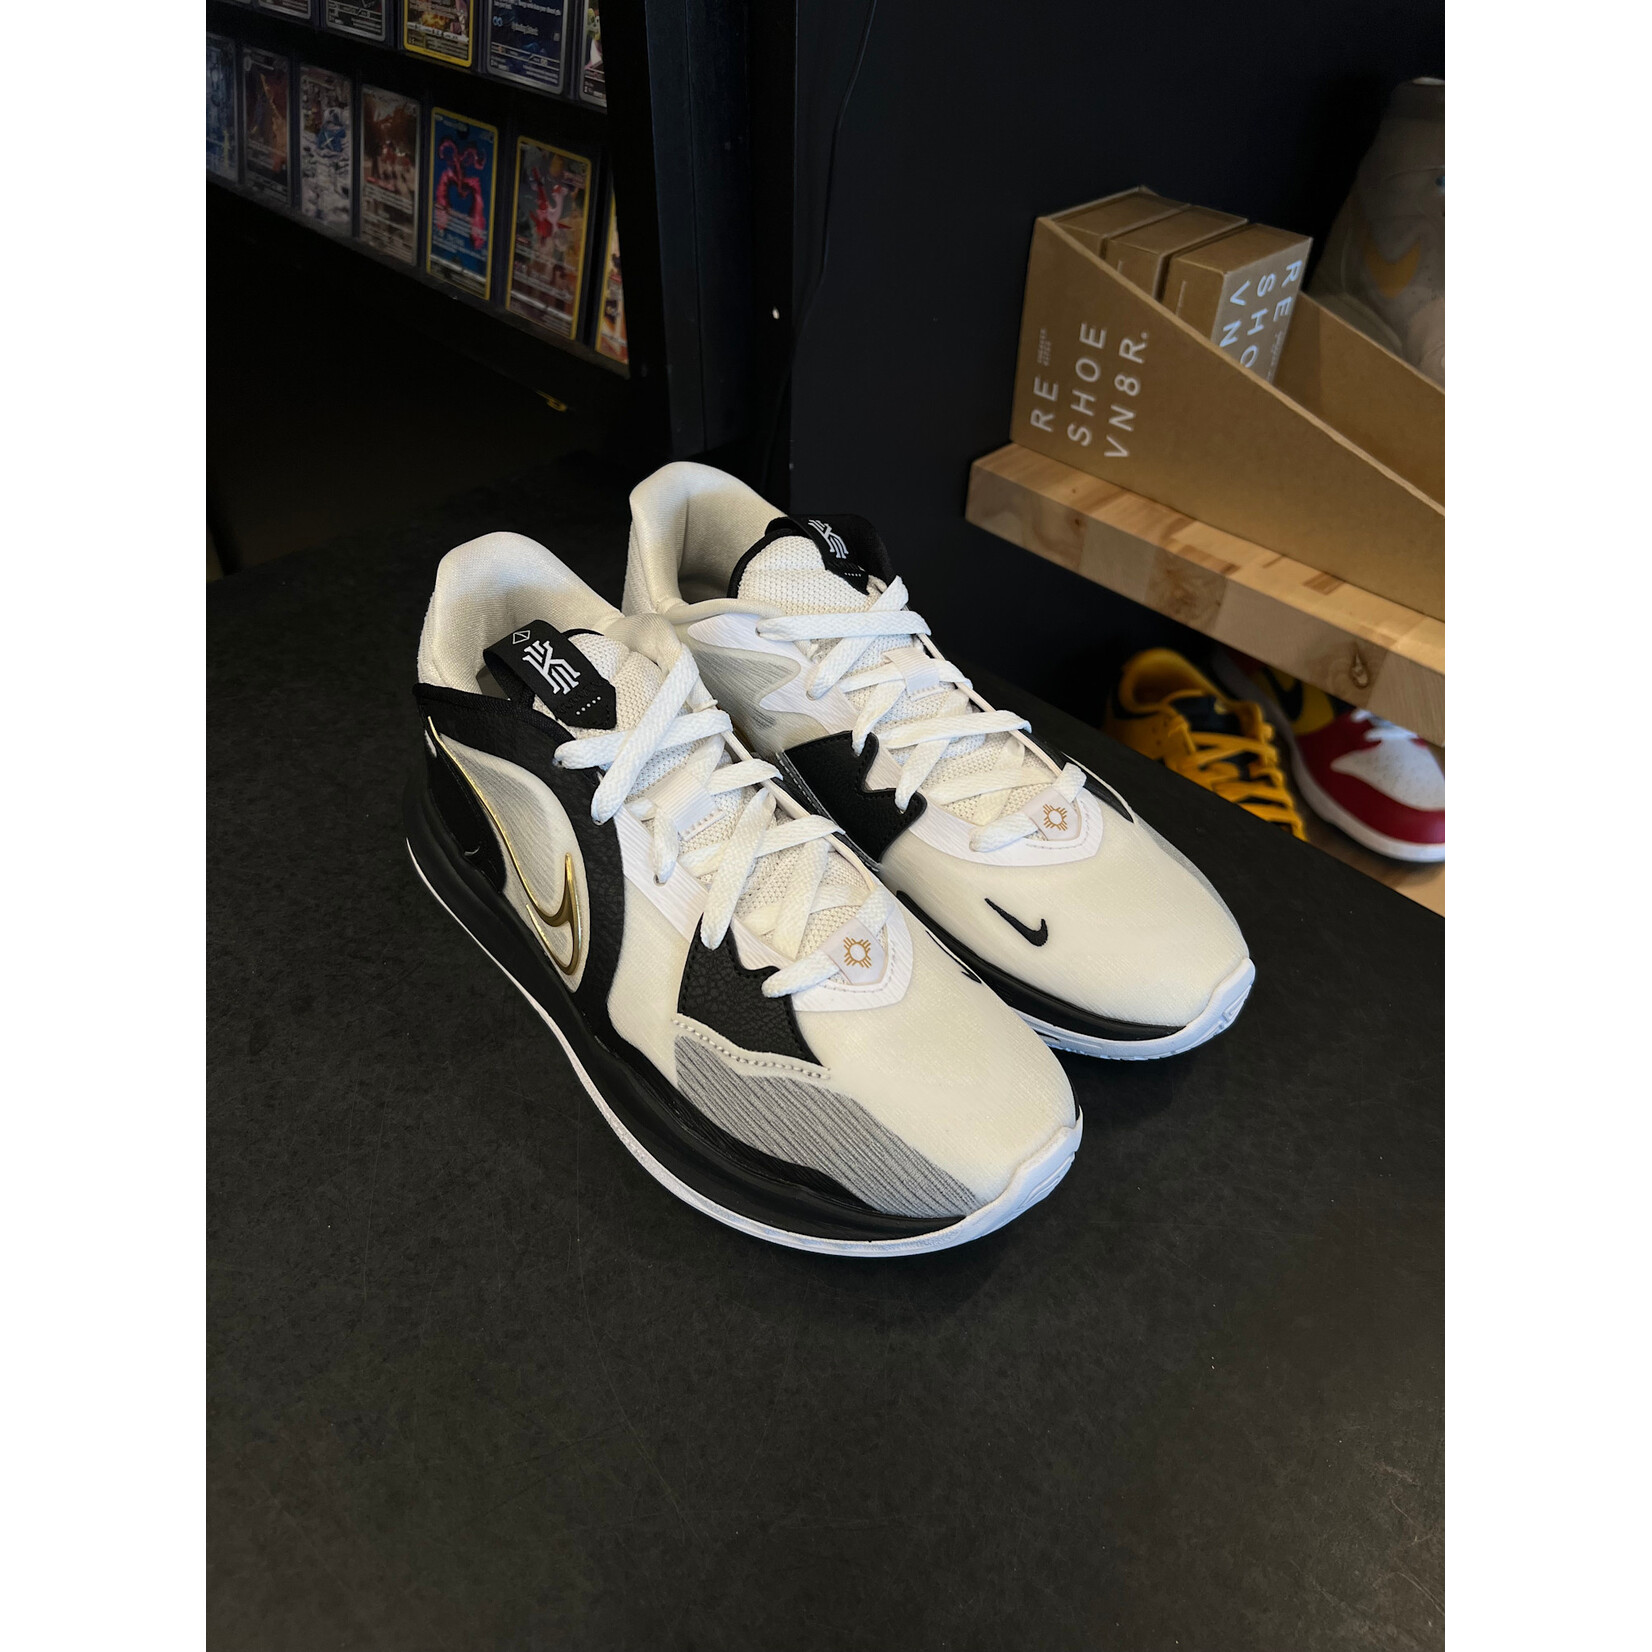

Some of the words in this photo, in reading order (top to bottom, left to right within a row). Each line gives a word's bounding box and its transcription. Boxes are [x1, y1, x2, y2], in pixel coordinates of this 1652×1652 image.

[1273, 260, 1302, 322] RE
[1030, 376, 1059, 432] RE
[1067, 322, 1107, 447] SHOE
[1104, 331, 1149, 457] VN8R.
